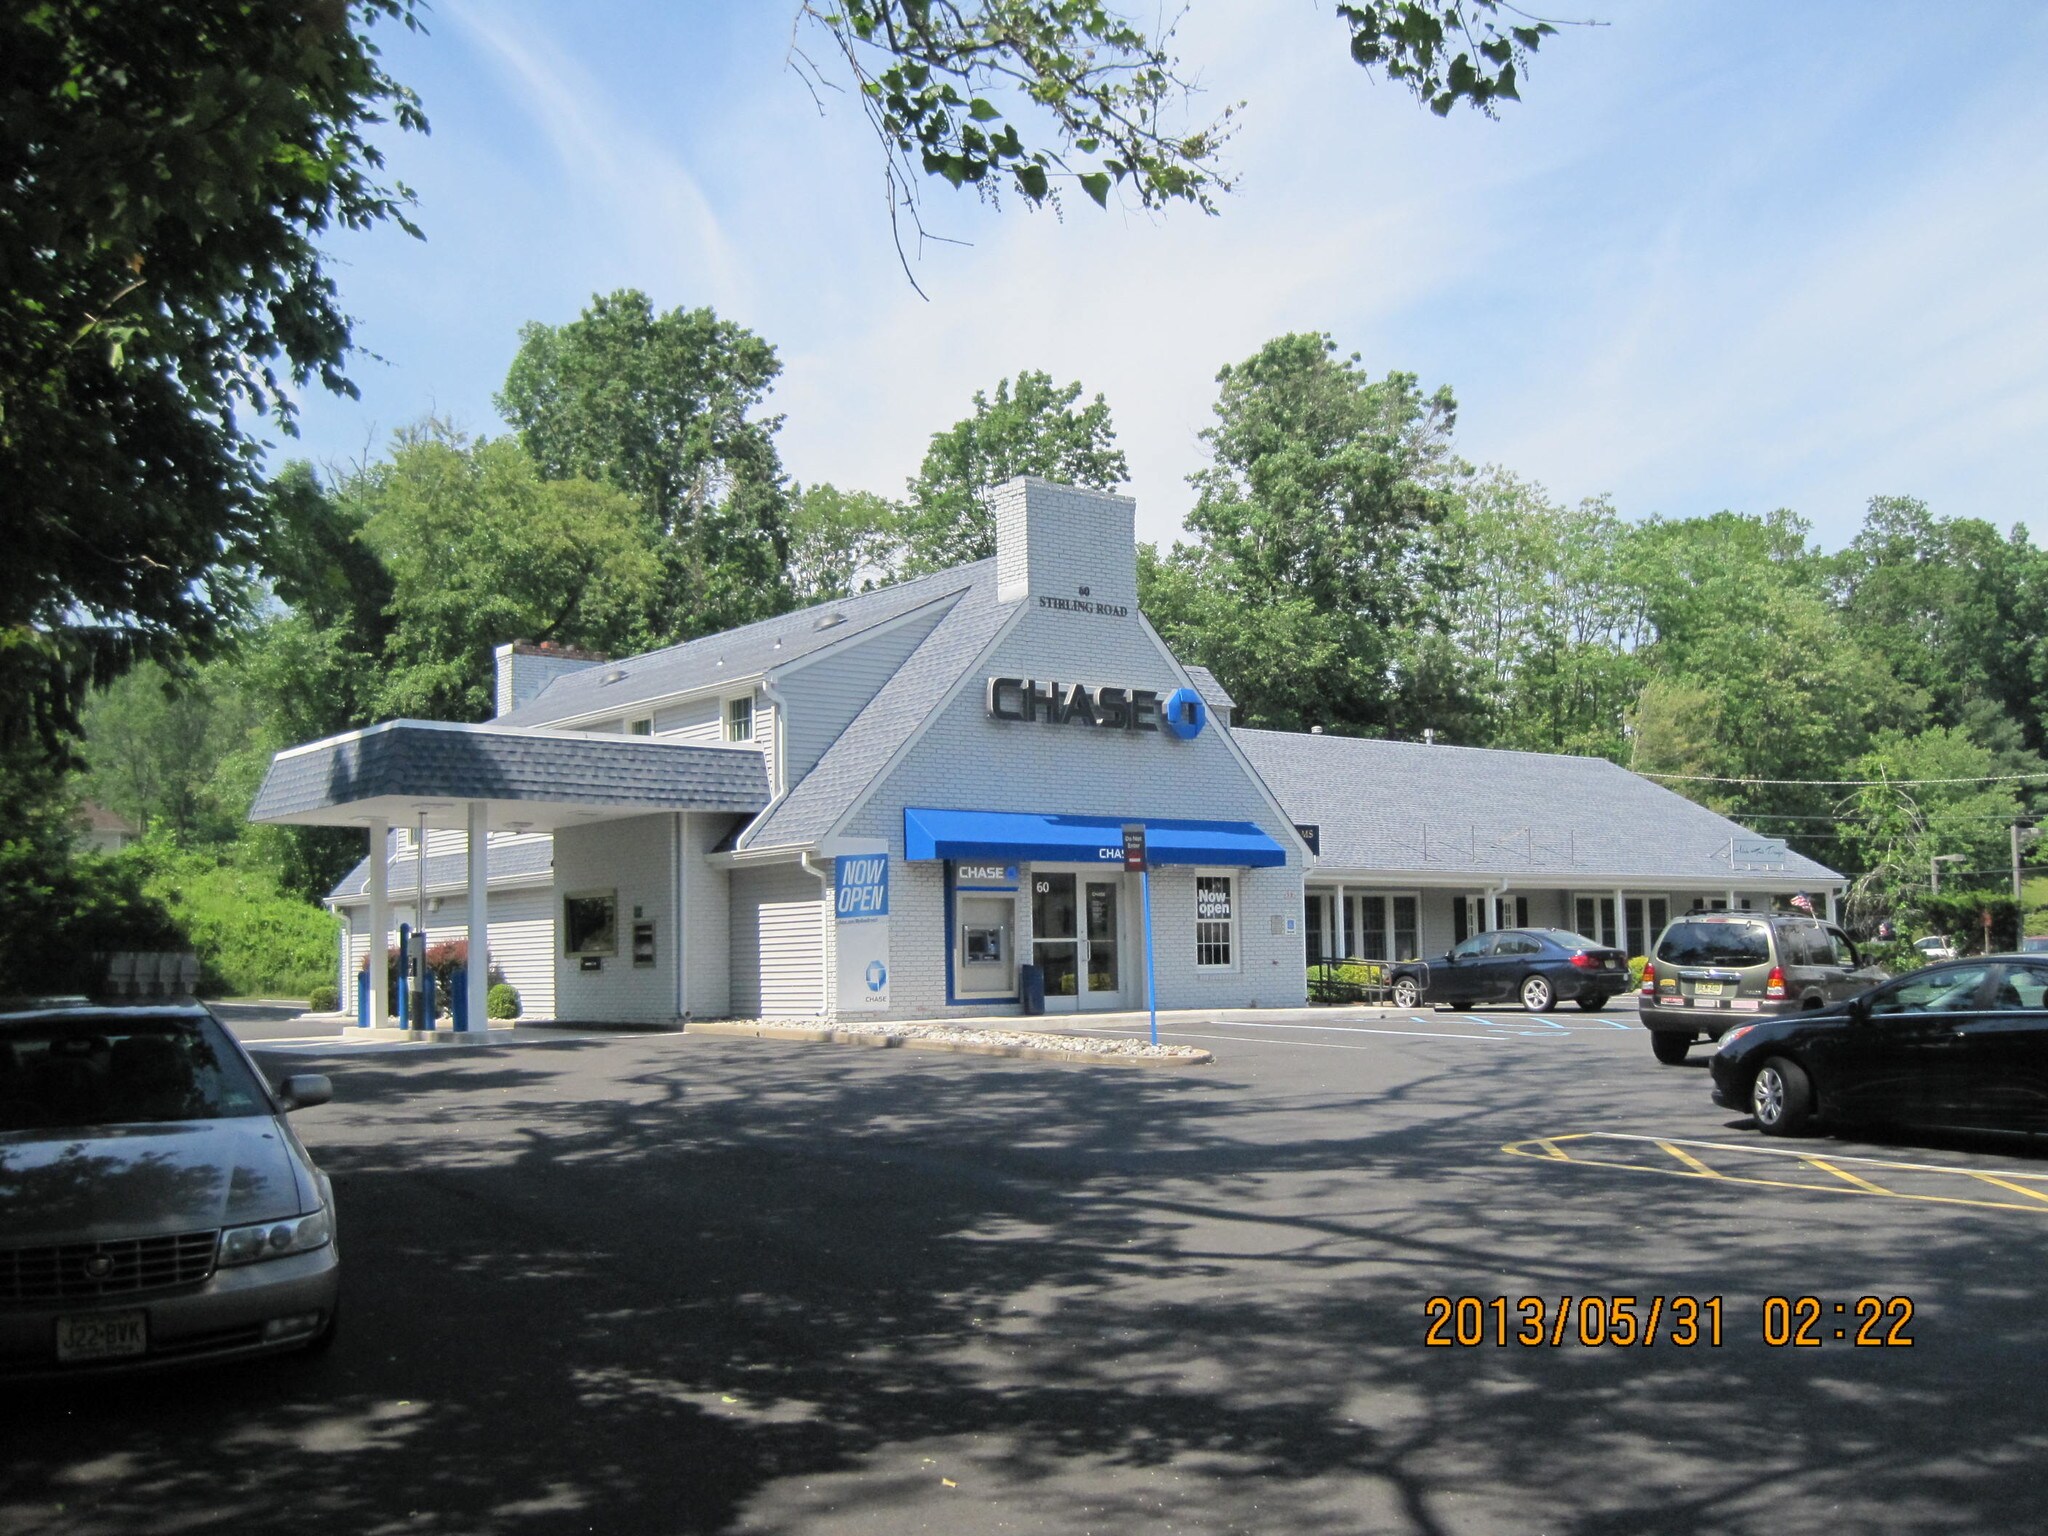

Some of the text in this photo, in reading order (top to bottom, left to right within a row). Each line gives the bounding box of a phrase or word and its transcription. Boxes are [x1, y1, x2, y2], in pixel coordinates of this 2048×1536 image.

[1078, 586, 1090, 597] 60
[1040, 596, 1128, 617] STIRLING ROAD
[986, 677, 1159, 732] CHASE
[1098, 848, 1125, 859] CHA
[842, 860, 885, 885] NOW
[959, 866, 1005, 879] CHASE
[1036, 881, 1050, 893] 60
[838, 886, 884, 912] OPEN
[1198, 888, 1227, 903] Now
[1199, 903, 1230, 917] open
